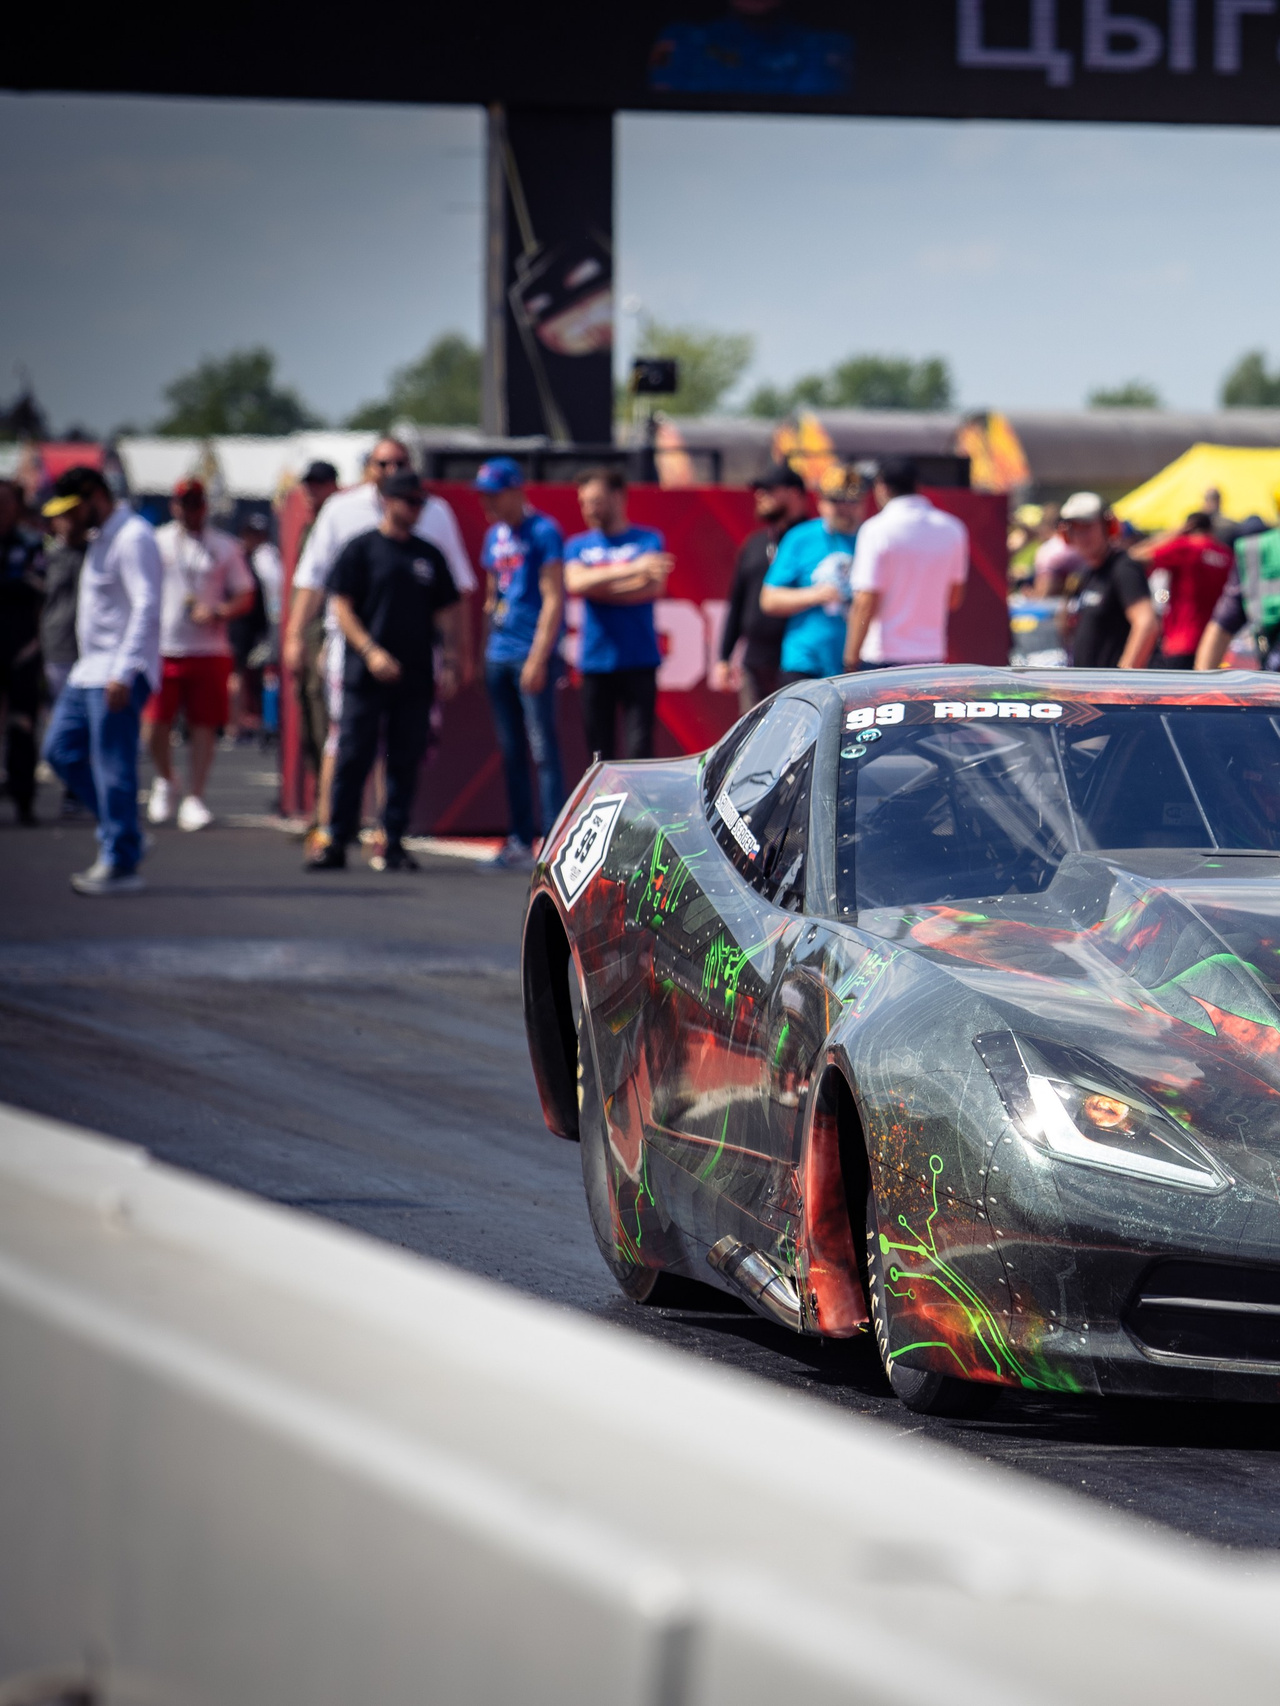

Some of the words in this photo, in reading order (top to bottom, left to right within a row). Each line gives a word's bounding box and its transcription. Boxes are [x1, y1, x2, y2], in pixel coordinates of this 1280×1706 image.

[846, 703, 905, 729] 99
[933, 702, 1063, 718] RDRC
[731, 818, 757, 854] SERGEY
